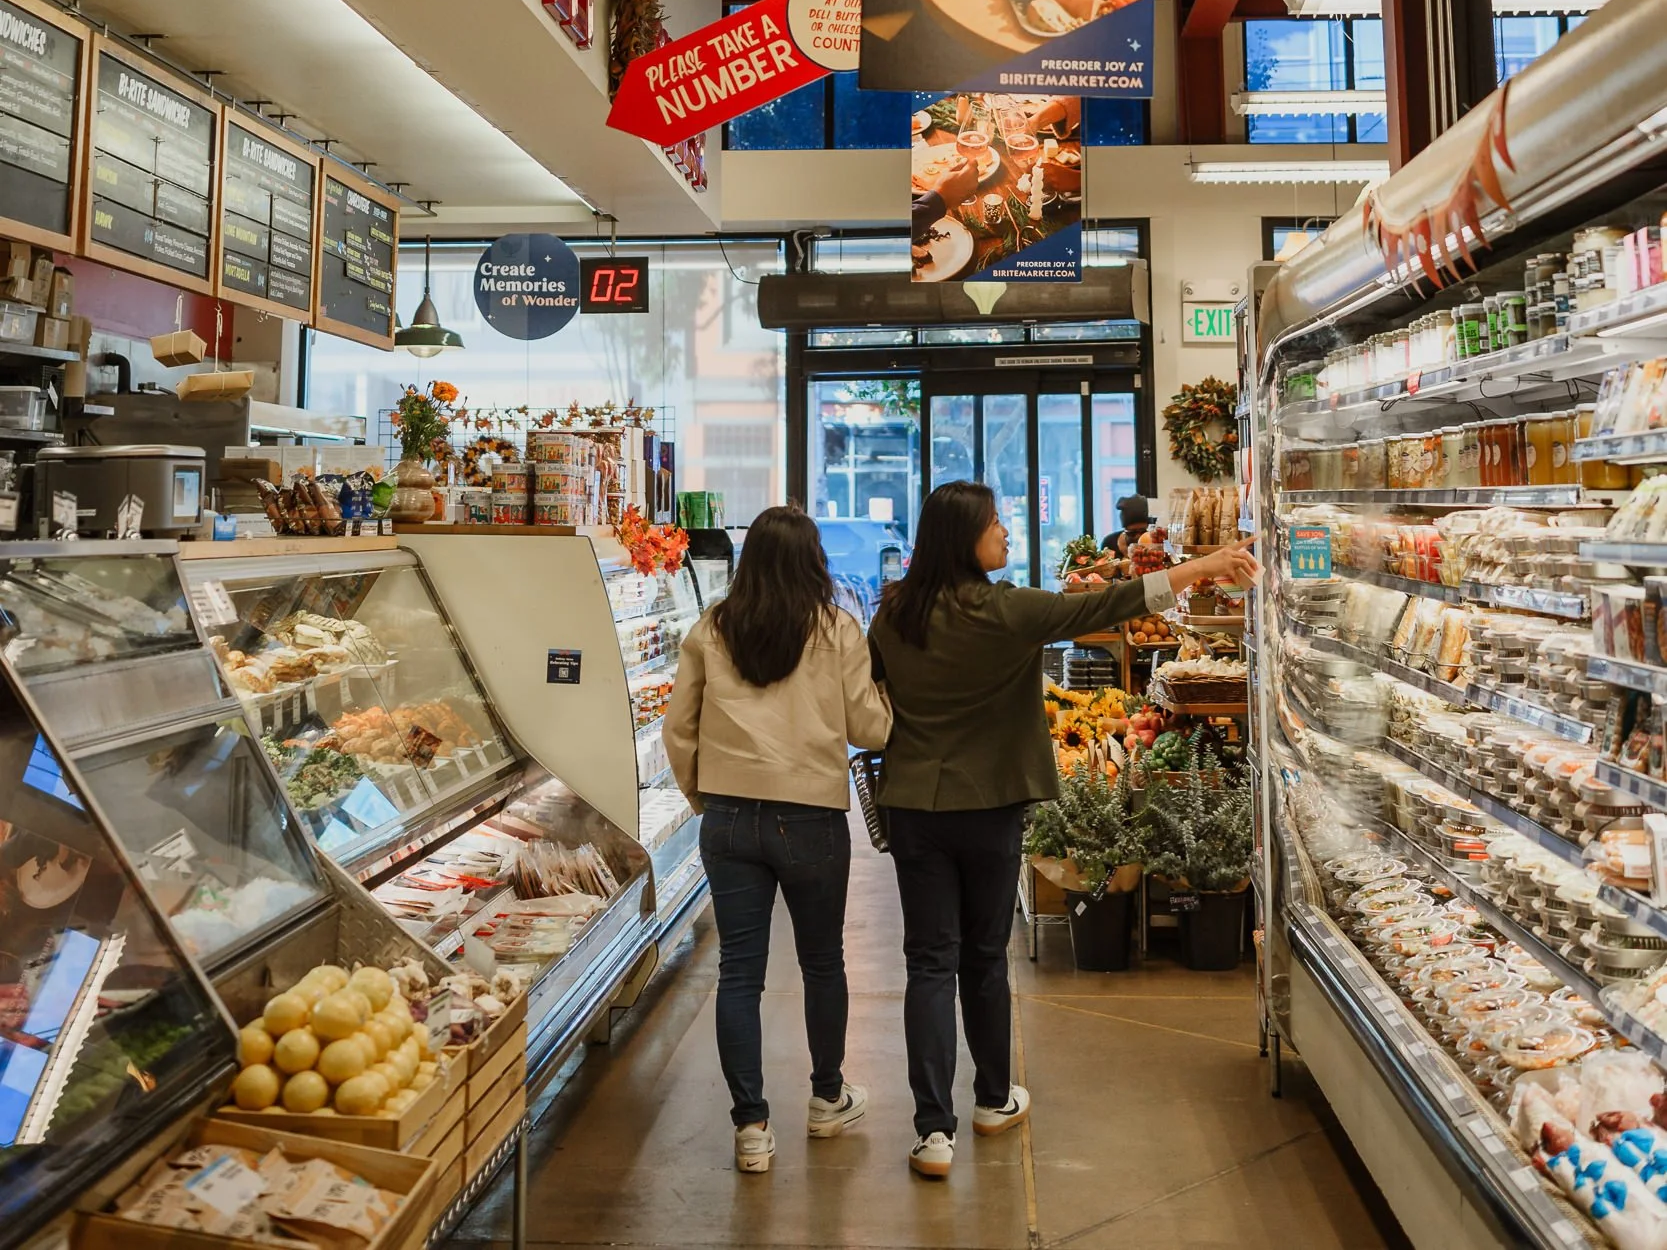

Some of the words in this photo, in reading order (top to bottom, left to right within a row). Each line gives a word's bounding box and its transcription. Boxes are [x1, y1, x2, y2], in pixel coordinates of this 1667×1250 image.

[835, 10, 863, 23] BUTC
[810, 21, 824, 32] OR
[812, 35, 860, 52] COUNT
[644, 45, 708, 93] PLEASE
[706, 21, 760, 61] TAKE
[760, 13, 781, 40] A
[1041, 59, 1102, 71] PREORDER
[1104, 61, 1126, 72] JOY
[1128, 62, 1145, 72] AT
[655, 38, 800, 126] NUMBER
[999, 72, 1144, 89] BIRITEMARKET.COM
[118, 72, 148, 107] BI-RITE
[146, 88, 191, 129] SANDWICHES
[242, 137, 264, 164] BI-RITE
[263, 148, 297, 181] SANDWICHES
[480, 262, 536, 277] Create
[992, 269, 1076, 277] BIRITEMARKET.COM
[480, 277, 566, 292] Memories
[590, 269, 639, 301] 02
[502, 294, 518, 306] of
[521, 294, 578, 307] Wonder
[1194, 308, 1233, 337] EXIT
